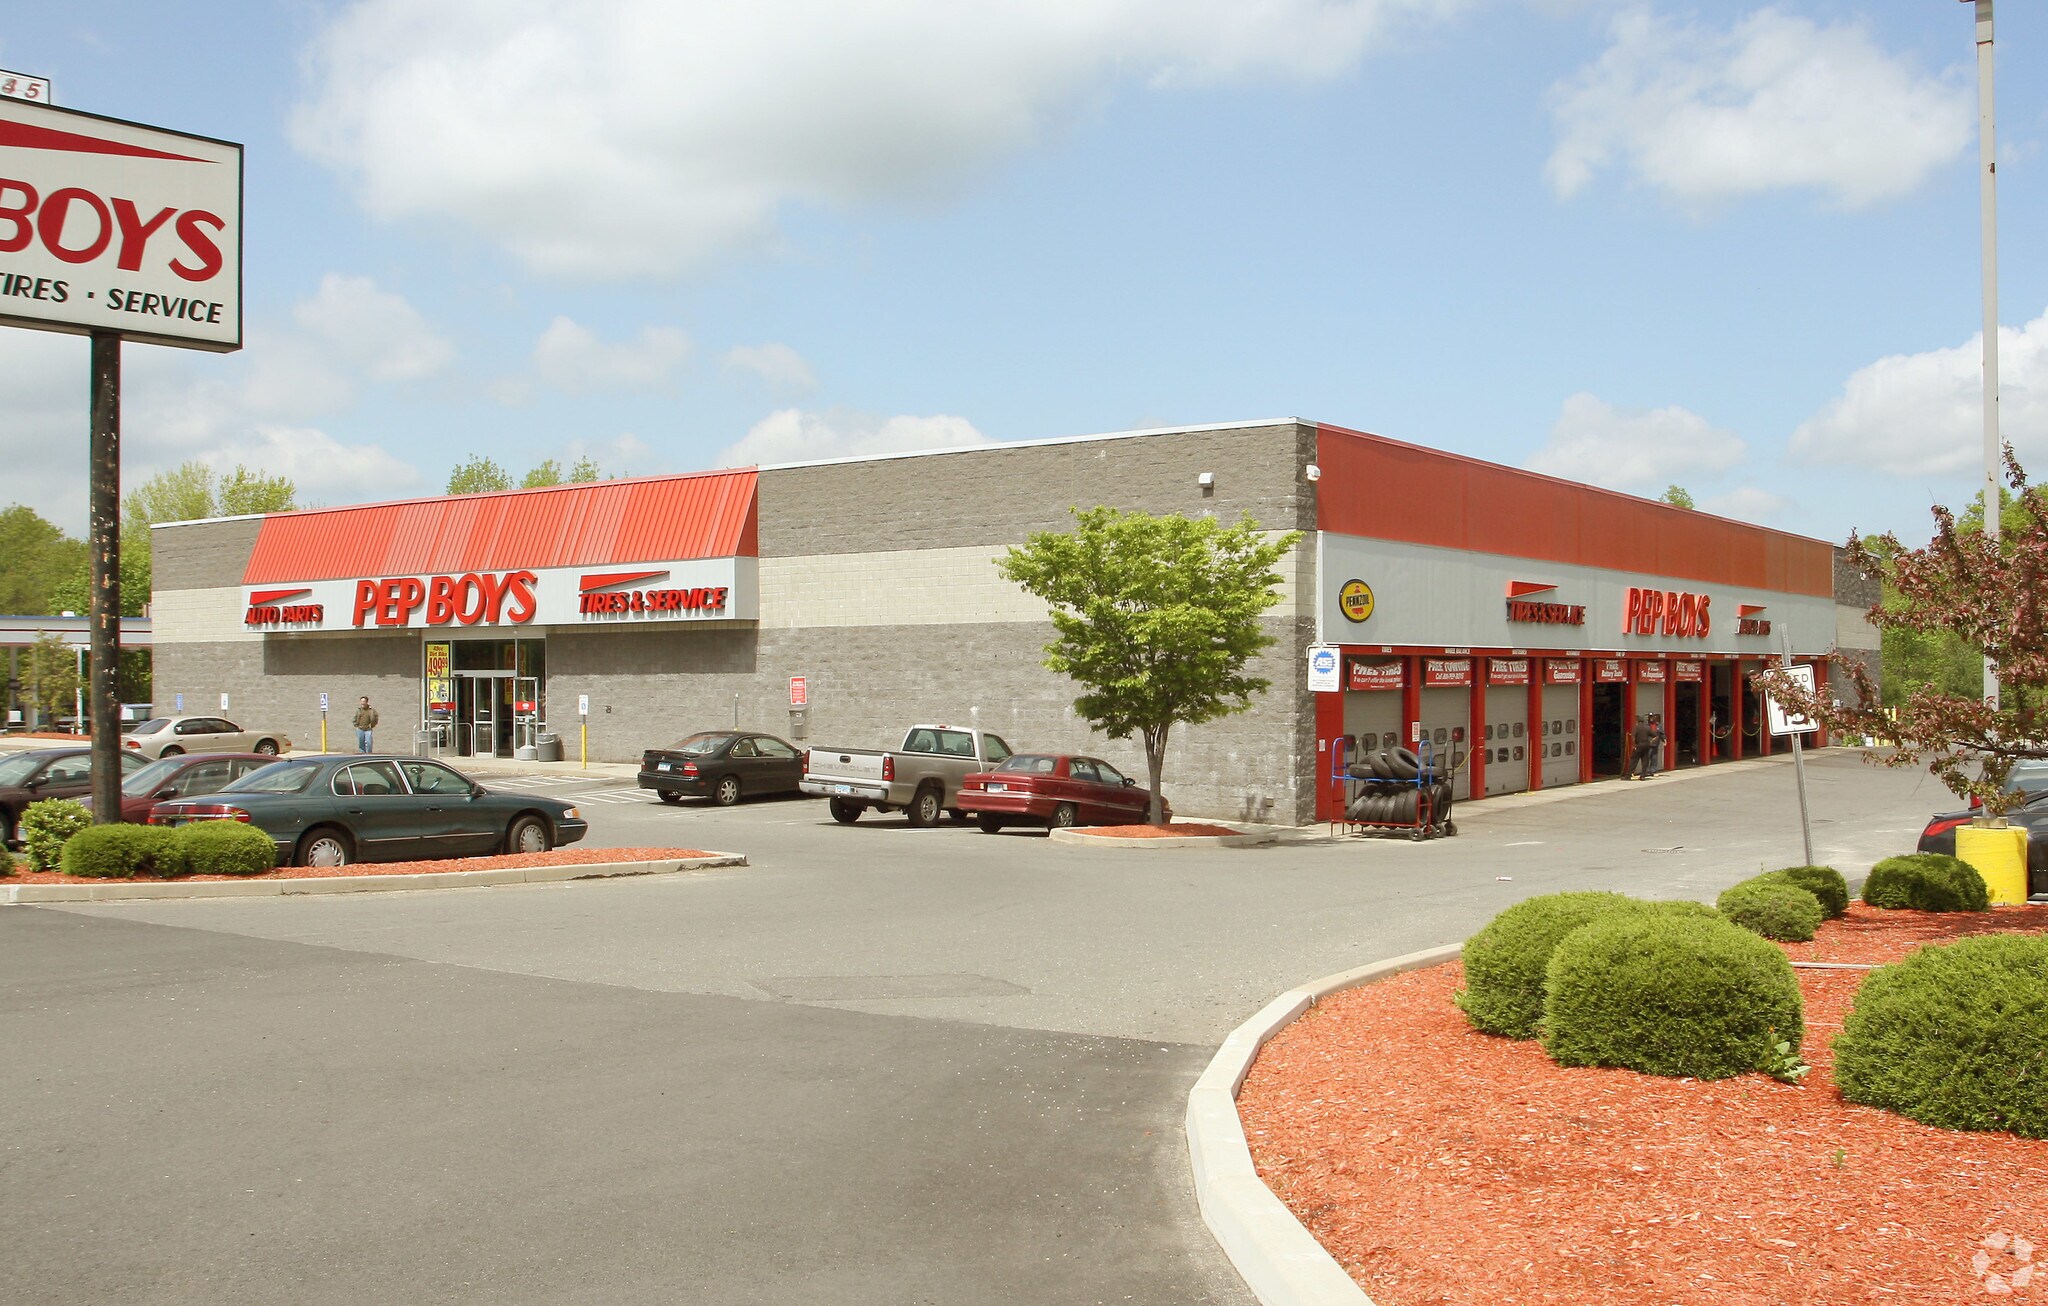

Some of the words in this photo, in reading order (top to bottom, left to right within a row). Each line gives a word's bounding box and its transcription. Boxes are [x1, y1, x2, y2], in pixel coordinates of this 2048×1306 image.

[0, 178, 226, 282] BOYS
[106, 288, 224, 324] SERVICE
[352, 578, 427, 625] PEP
[426, 570, 538, 624] BOYS
[578, 591, 630, 613] TIRES
[630, 590, 644, 612] &
[644, 586, 729, 611] SERVICE
[1346, 593, 1370, 608] PENNZOIL
[244, 606, 281, 625] AUTO
[281, 604, 324, 623] PARTS
[1622, 586, 1664, 635] PEP
[1662, 592, 1712, 638] BOYS
[1428, 661, 1444, 671] FREE
[1444, 661, 1471, 672] TOWING
[1491, 660, 1508, 672] FREE
[812, 762, 879, 773] CHEVROLET
